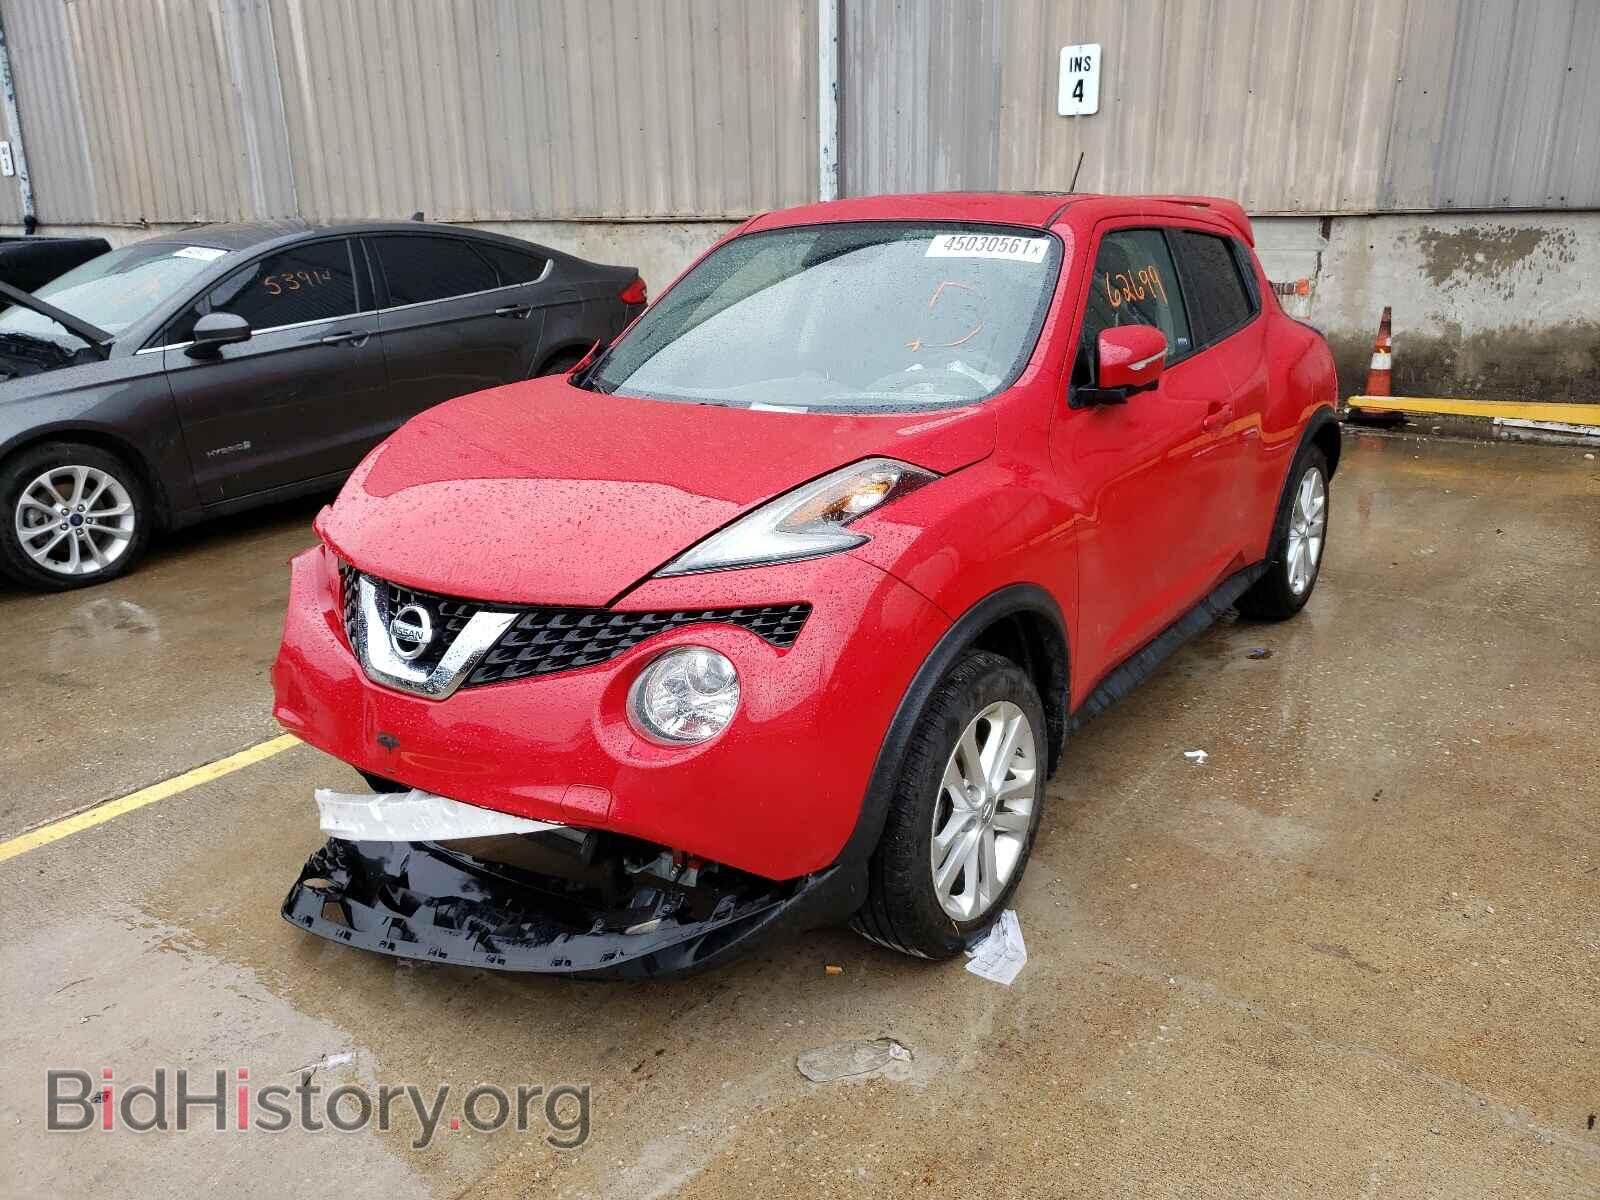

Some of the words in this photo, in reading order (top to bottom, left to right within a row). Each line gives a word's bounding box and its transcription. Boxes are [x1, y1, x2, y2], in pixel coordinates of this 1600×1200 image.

[1068, 55, 1092, 73] INS
[1071, 78, 1085, 103] 4
[1105, 264, 1169, 308] 62699
[206, 441, 243, 457] HYD
[391, 619, 424, 640] NISSAN
